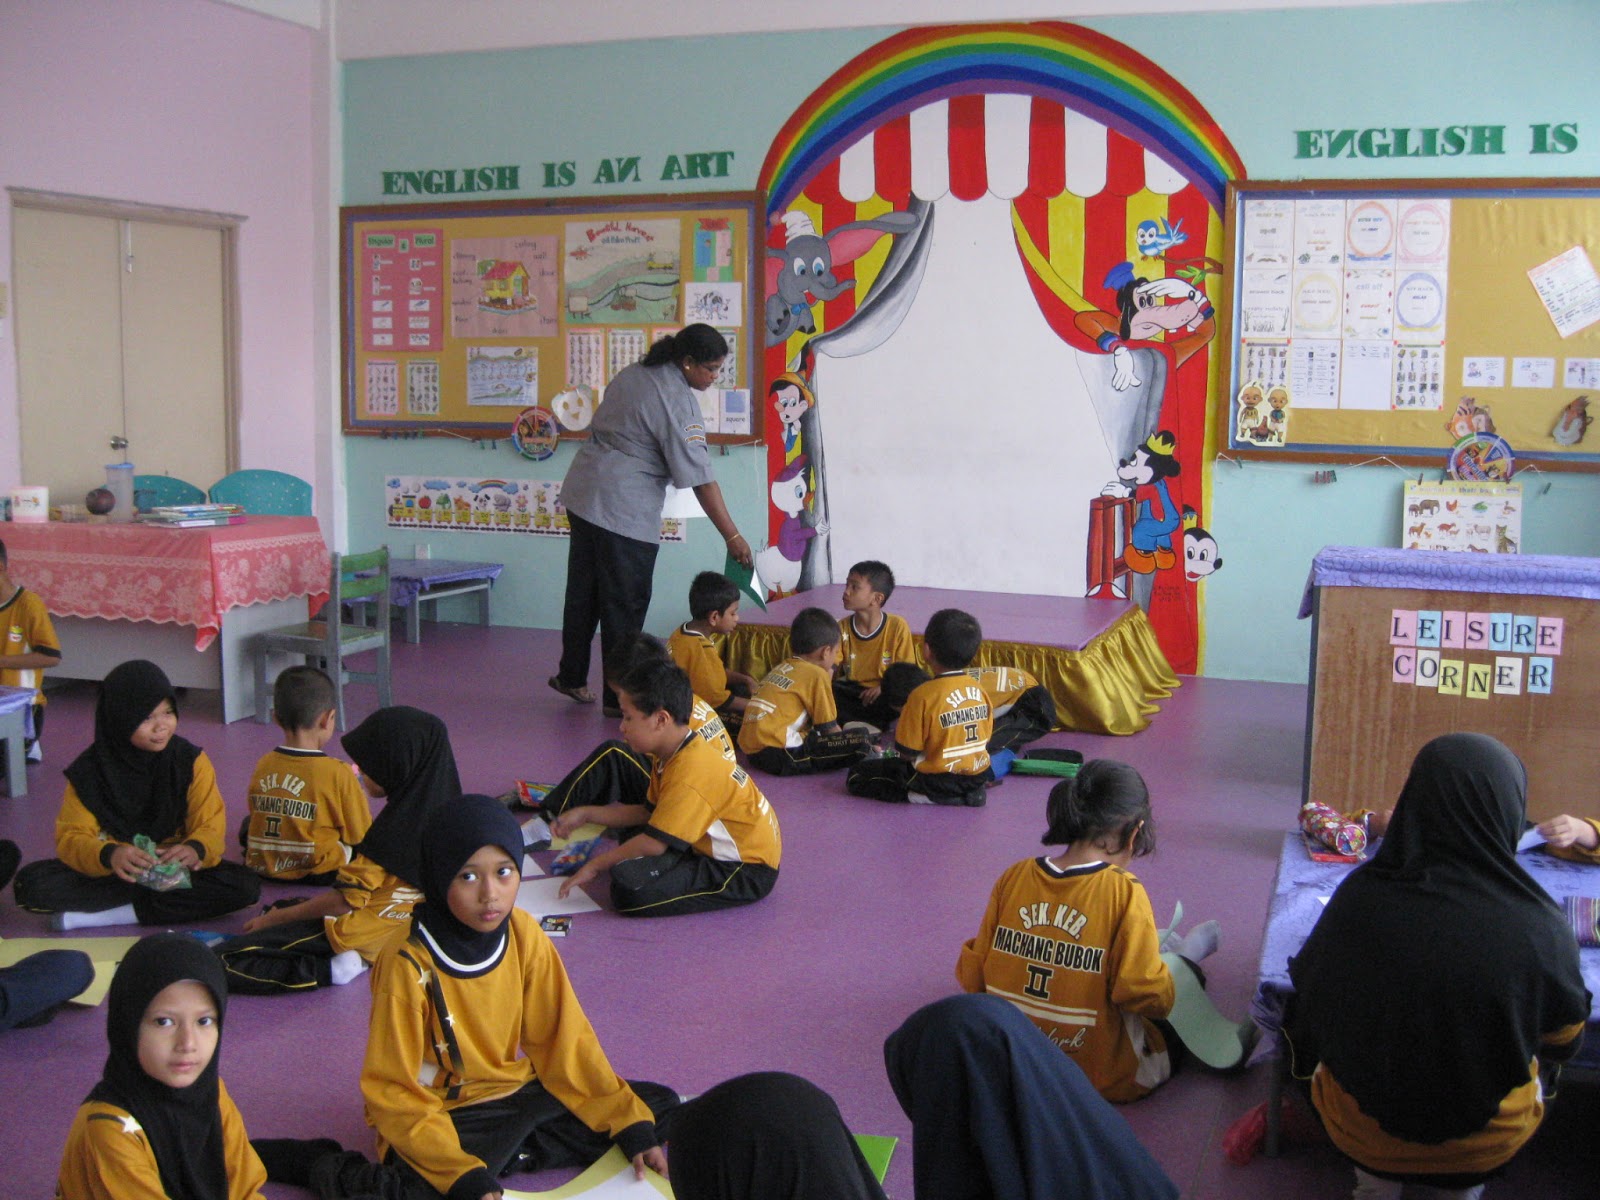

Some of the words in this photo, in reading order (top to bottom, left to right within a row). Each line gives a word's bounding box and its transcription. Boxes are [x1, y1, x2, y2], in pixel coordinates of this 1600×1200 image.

[1293, 124, 1506, 159] ENGLISH
[1528, 122, 1579, 155] IS
[382, 165, 520, 195] ENGLISH
[542, 160, 576, 188] IS
[593, 156, 641, 184] AN
[660, 151, 735, 181] ART
[1392, 616, 1558, 648] LEISURE
[1394, 654, 1549, 693] CORNER
[939, 706, 975, 729] MACHANG
[260, 773, 280, 793] SEK.
[281, 773, 306, 798] KEB.
[264, 816, 281, 838] II
[281, 797, 317, 821] BUBOK
[1018, 901, 1051, 930] SEK.
[1053, 903, 1088, 940] KEB.
[992, 926, 1054, 965] MACHANG
[1053, 940, 1105, 974] BUBOK
[1023, 964, 1054, 1000] II
